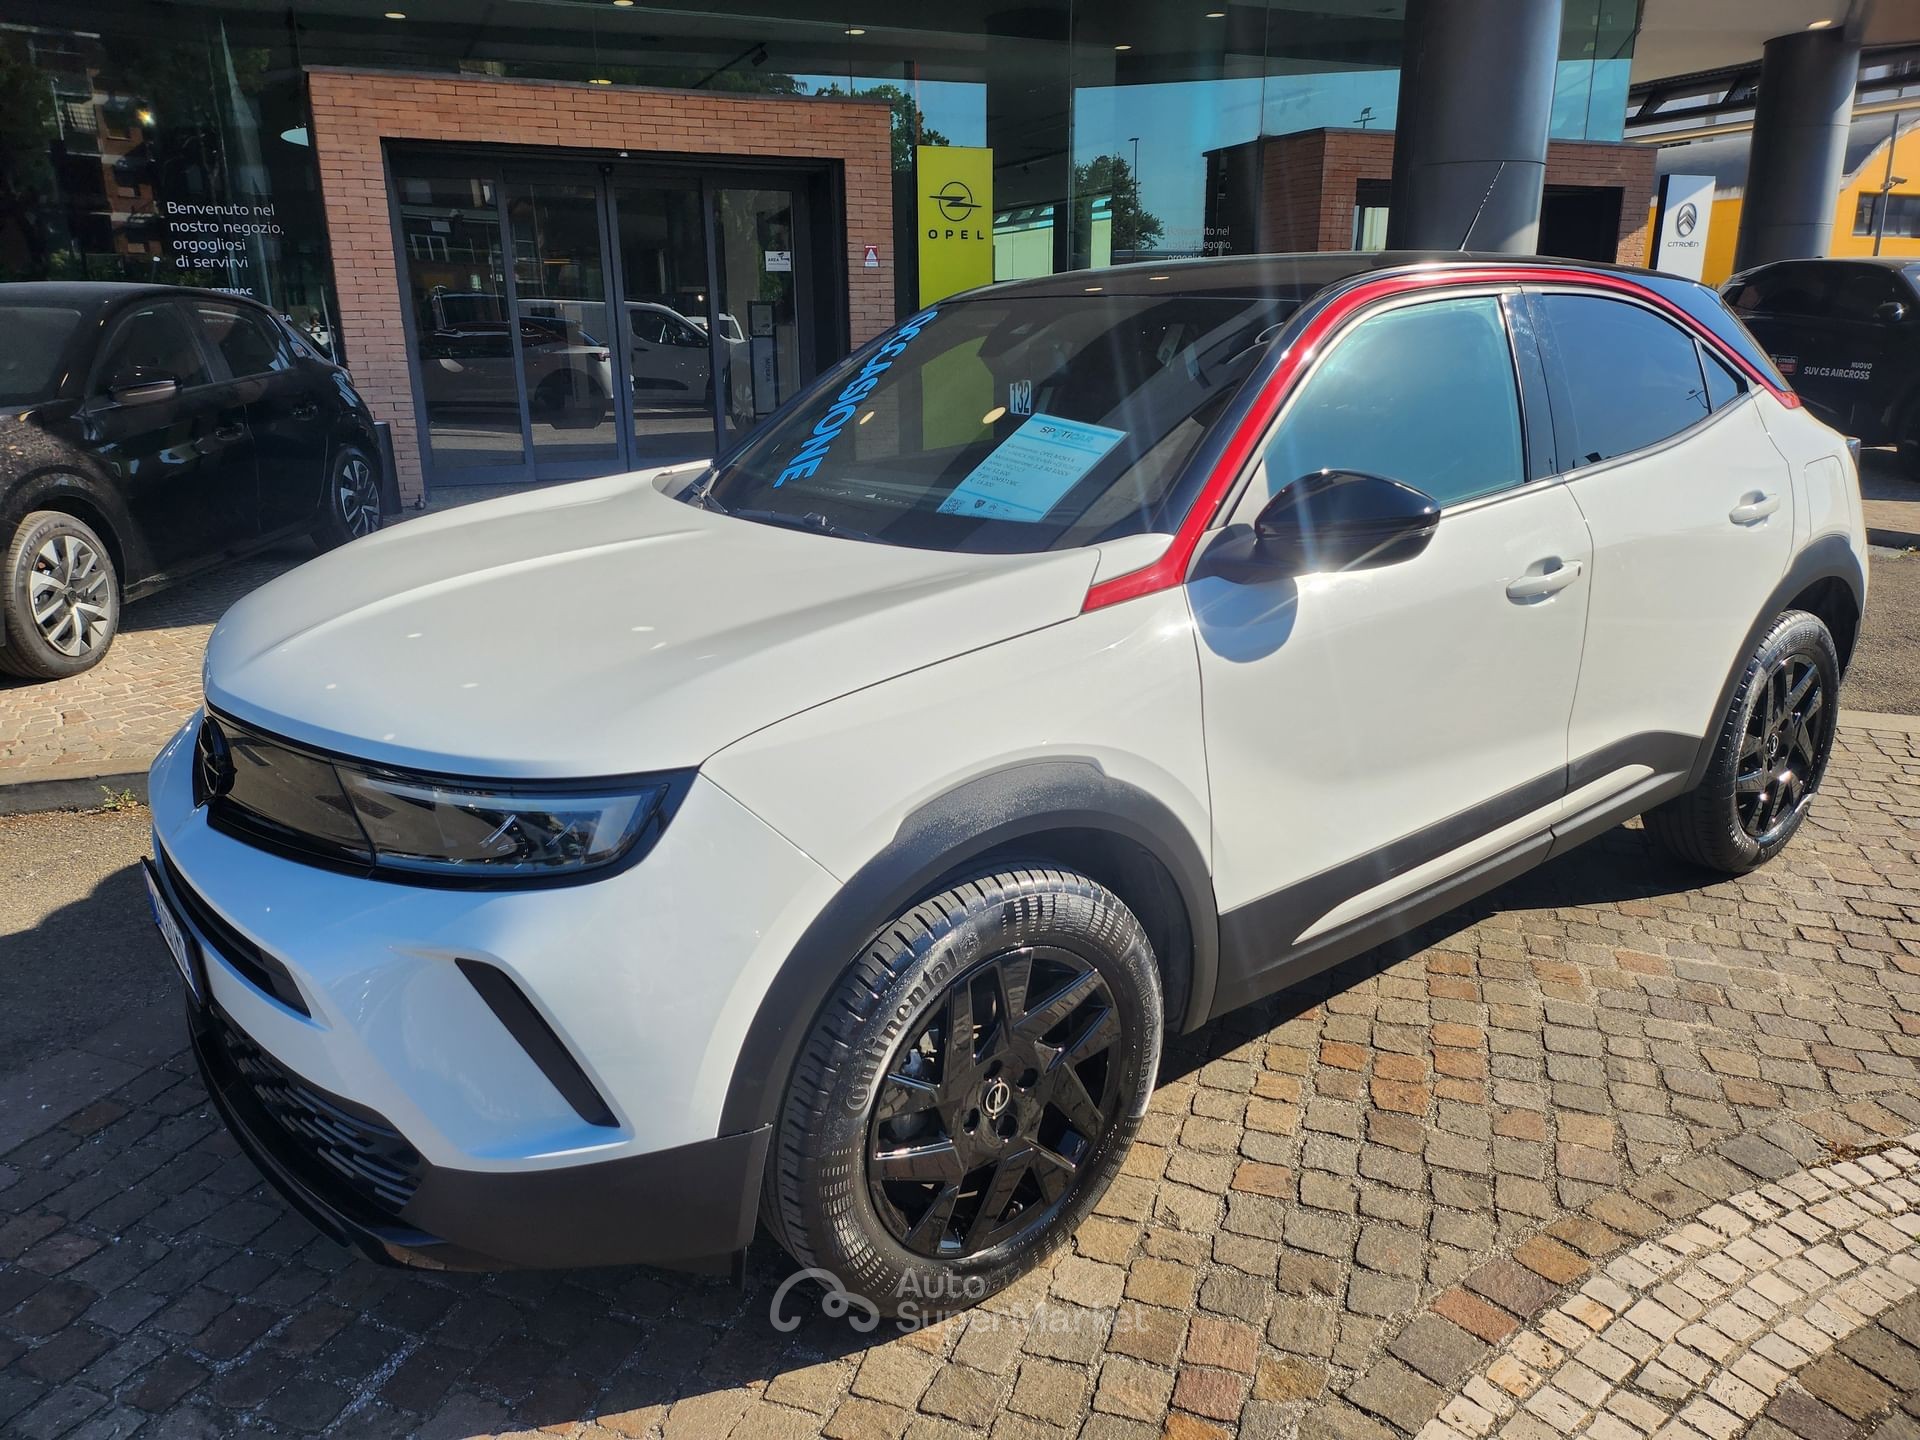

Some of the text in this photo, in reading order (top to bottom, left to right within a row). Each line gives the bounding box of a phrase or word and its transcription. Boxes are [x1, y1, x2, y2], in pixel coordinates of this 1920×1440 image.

[166, 201, 275, 216] Benvenuto nel
[169, 219, 285, 236] nostro negozio,
[928, 229, 985, 240] OPEL
[172, 237, 246, 254] orgogliosi
[175, 254, 249, 269] di servirvi
[1803, 366, 1820, 375] SUV
[1829, 368, 1871, 380] AIRCROSS
[1850, 361, 1873, 370] NUOVO
[772, 310, 939, 489] OCCASIONE
[1011, 381, 1030, 414] 132
